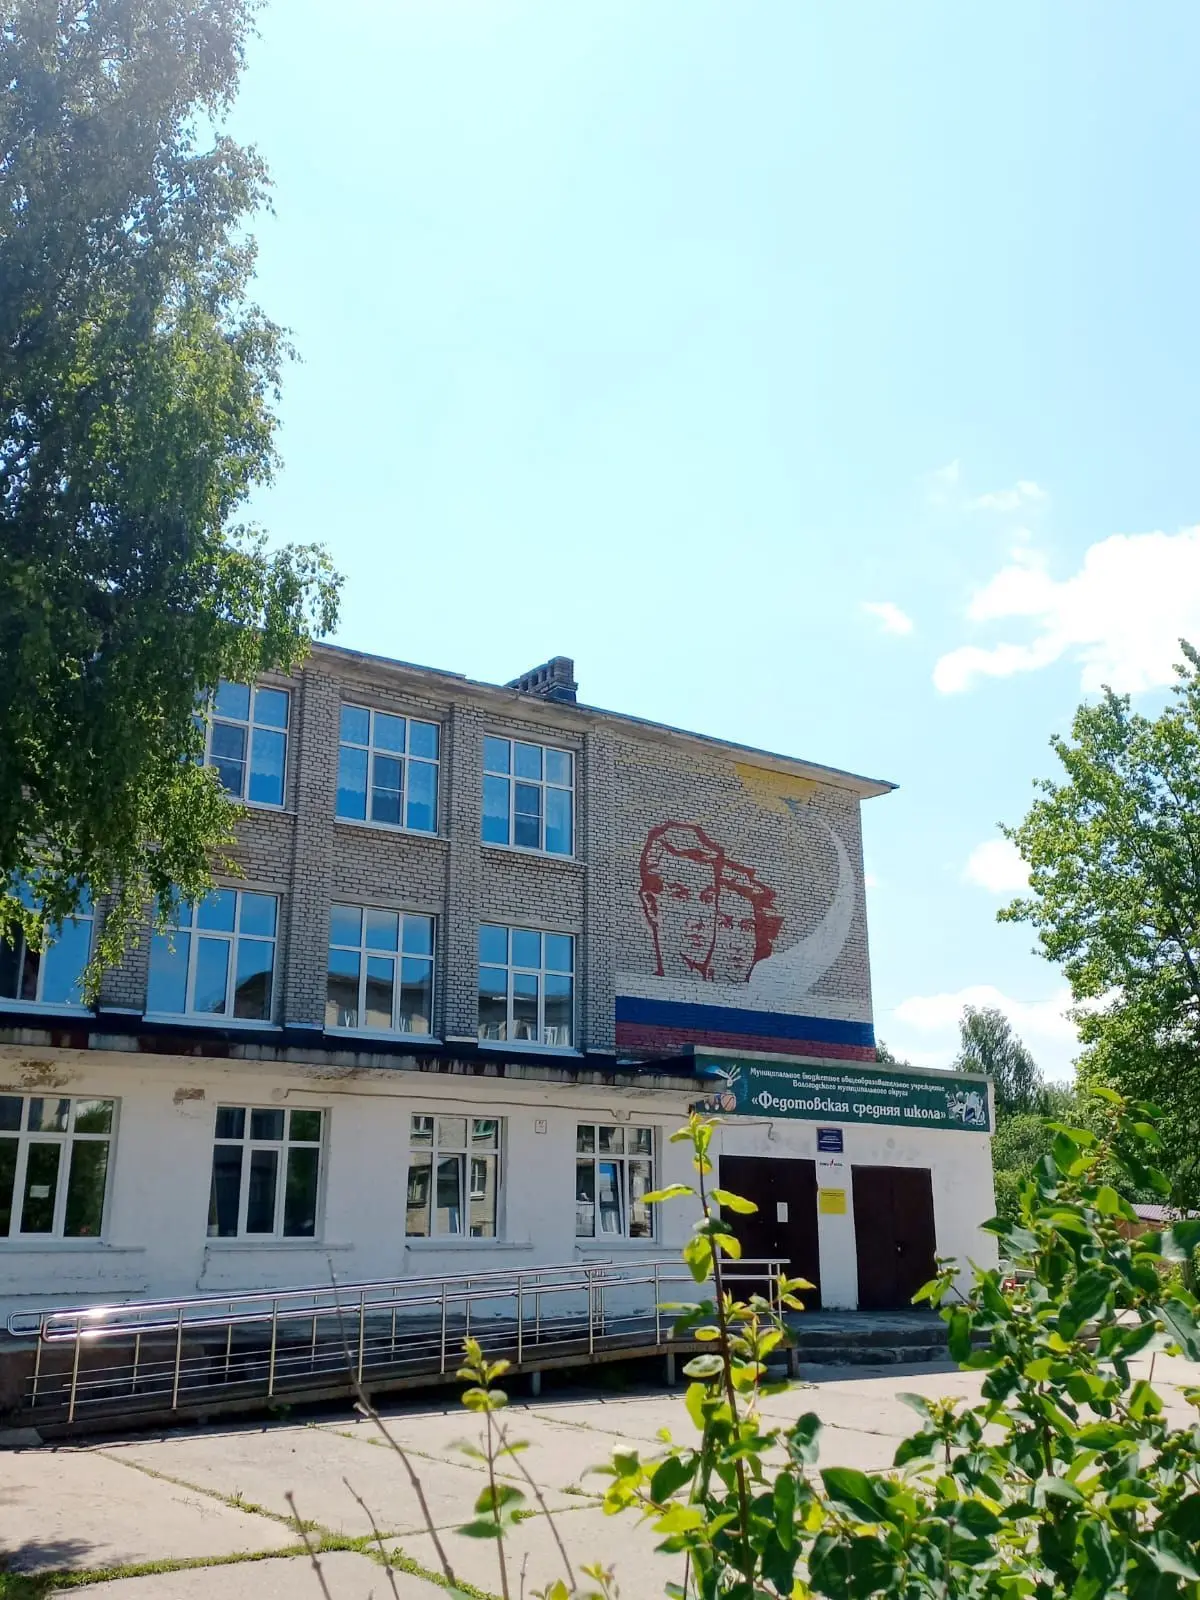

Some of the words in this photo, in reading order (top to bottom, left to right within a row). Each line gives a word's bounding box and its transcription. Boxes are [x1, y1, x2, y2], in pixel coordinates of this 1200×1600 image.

[750, 1067, 801, 1080] Муниципальное
[801, 1071, 840, 1082] бюджетное
[910, 1082, 945, 1092] учреждение
[792, 1080, 836, 1090] Вологодского
[837, 1085, 887, 1095] муниципального
[887, 1088, 908, 1097] округа
[751, 1090, 850, 1112] «Федотовская
[852, 1103, 900, 1118] средняя
[903, 1104, 946, 1120] школа»
